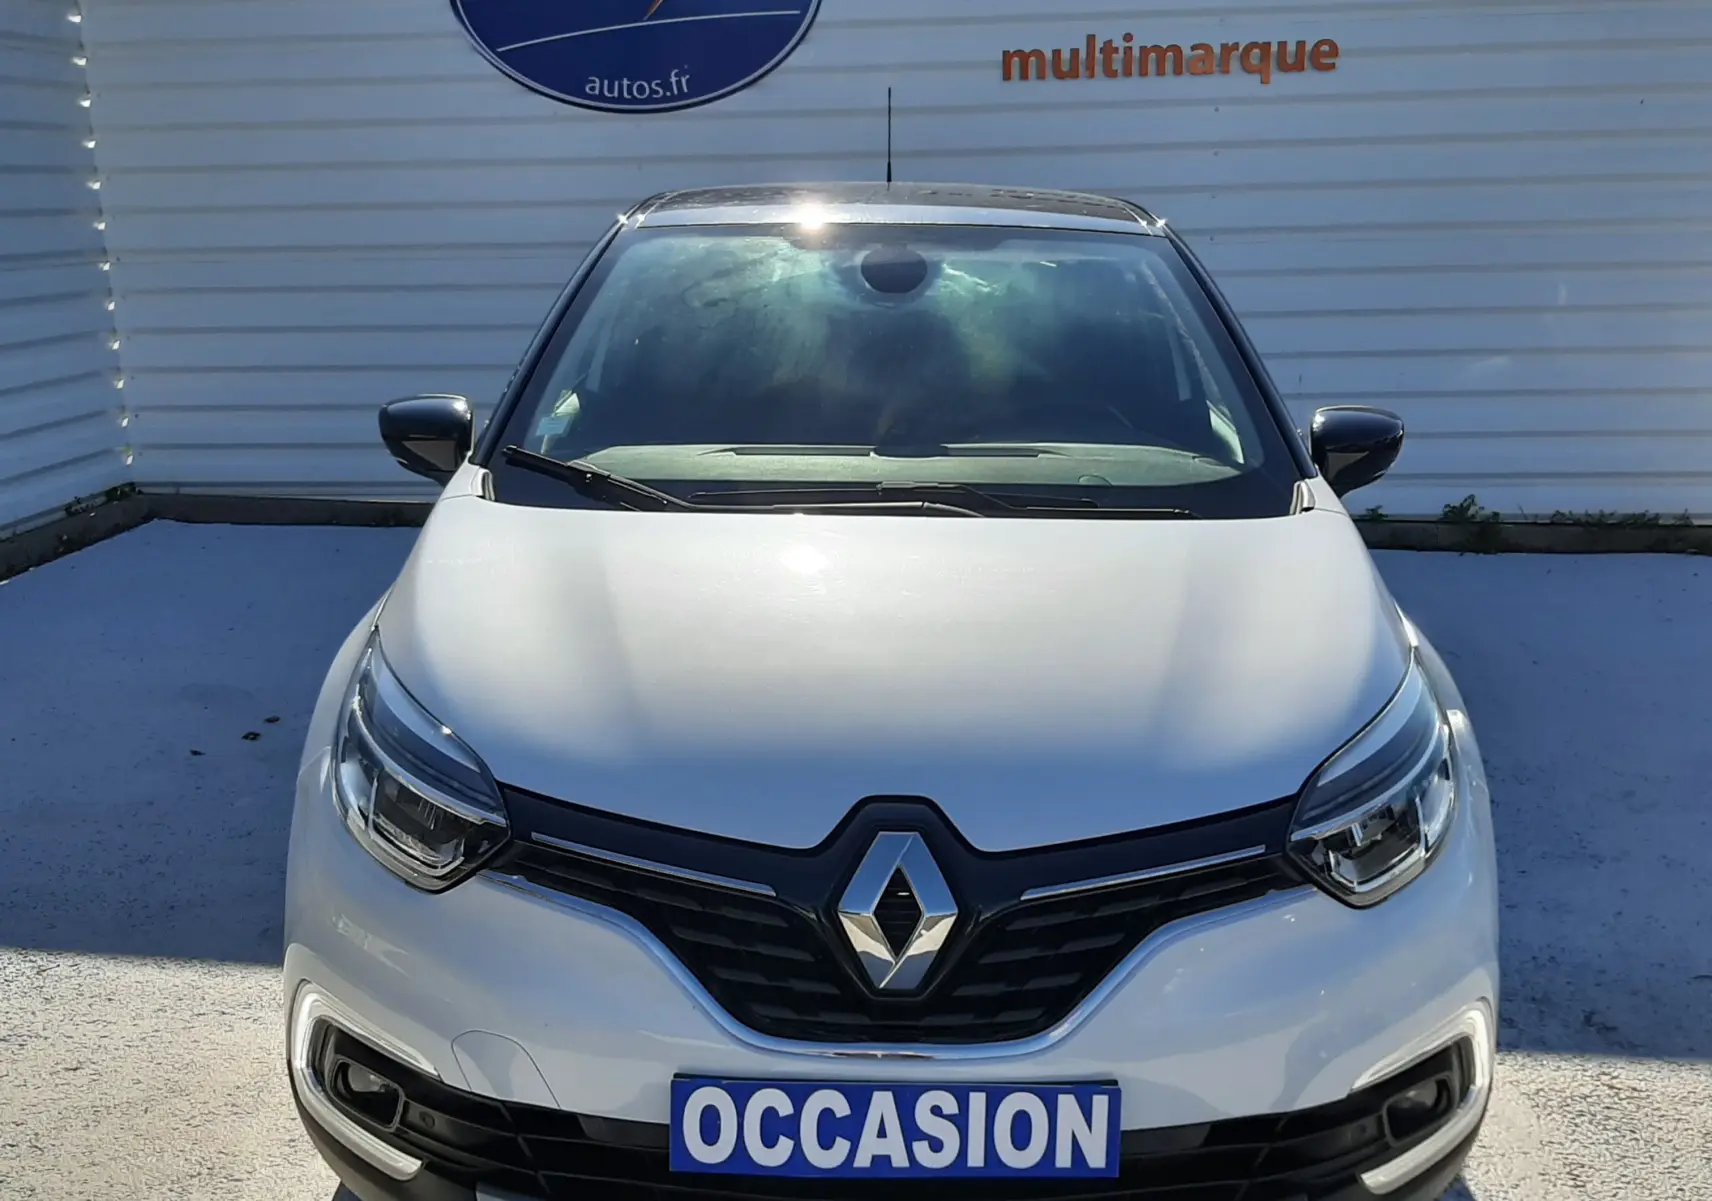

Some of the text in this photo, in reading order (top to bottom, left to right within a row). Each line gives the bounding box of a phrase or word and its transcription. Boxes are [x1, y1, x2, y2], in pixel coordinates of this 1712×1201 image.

[585, 69, 692, 99] autos.fr
[1002, 32, 1340, 84] multimarque
[682, 1086, 1109, 1169] OCCASION
